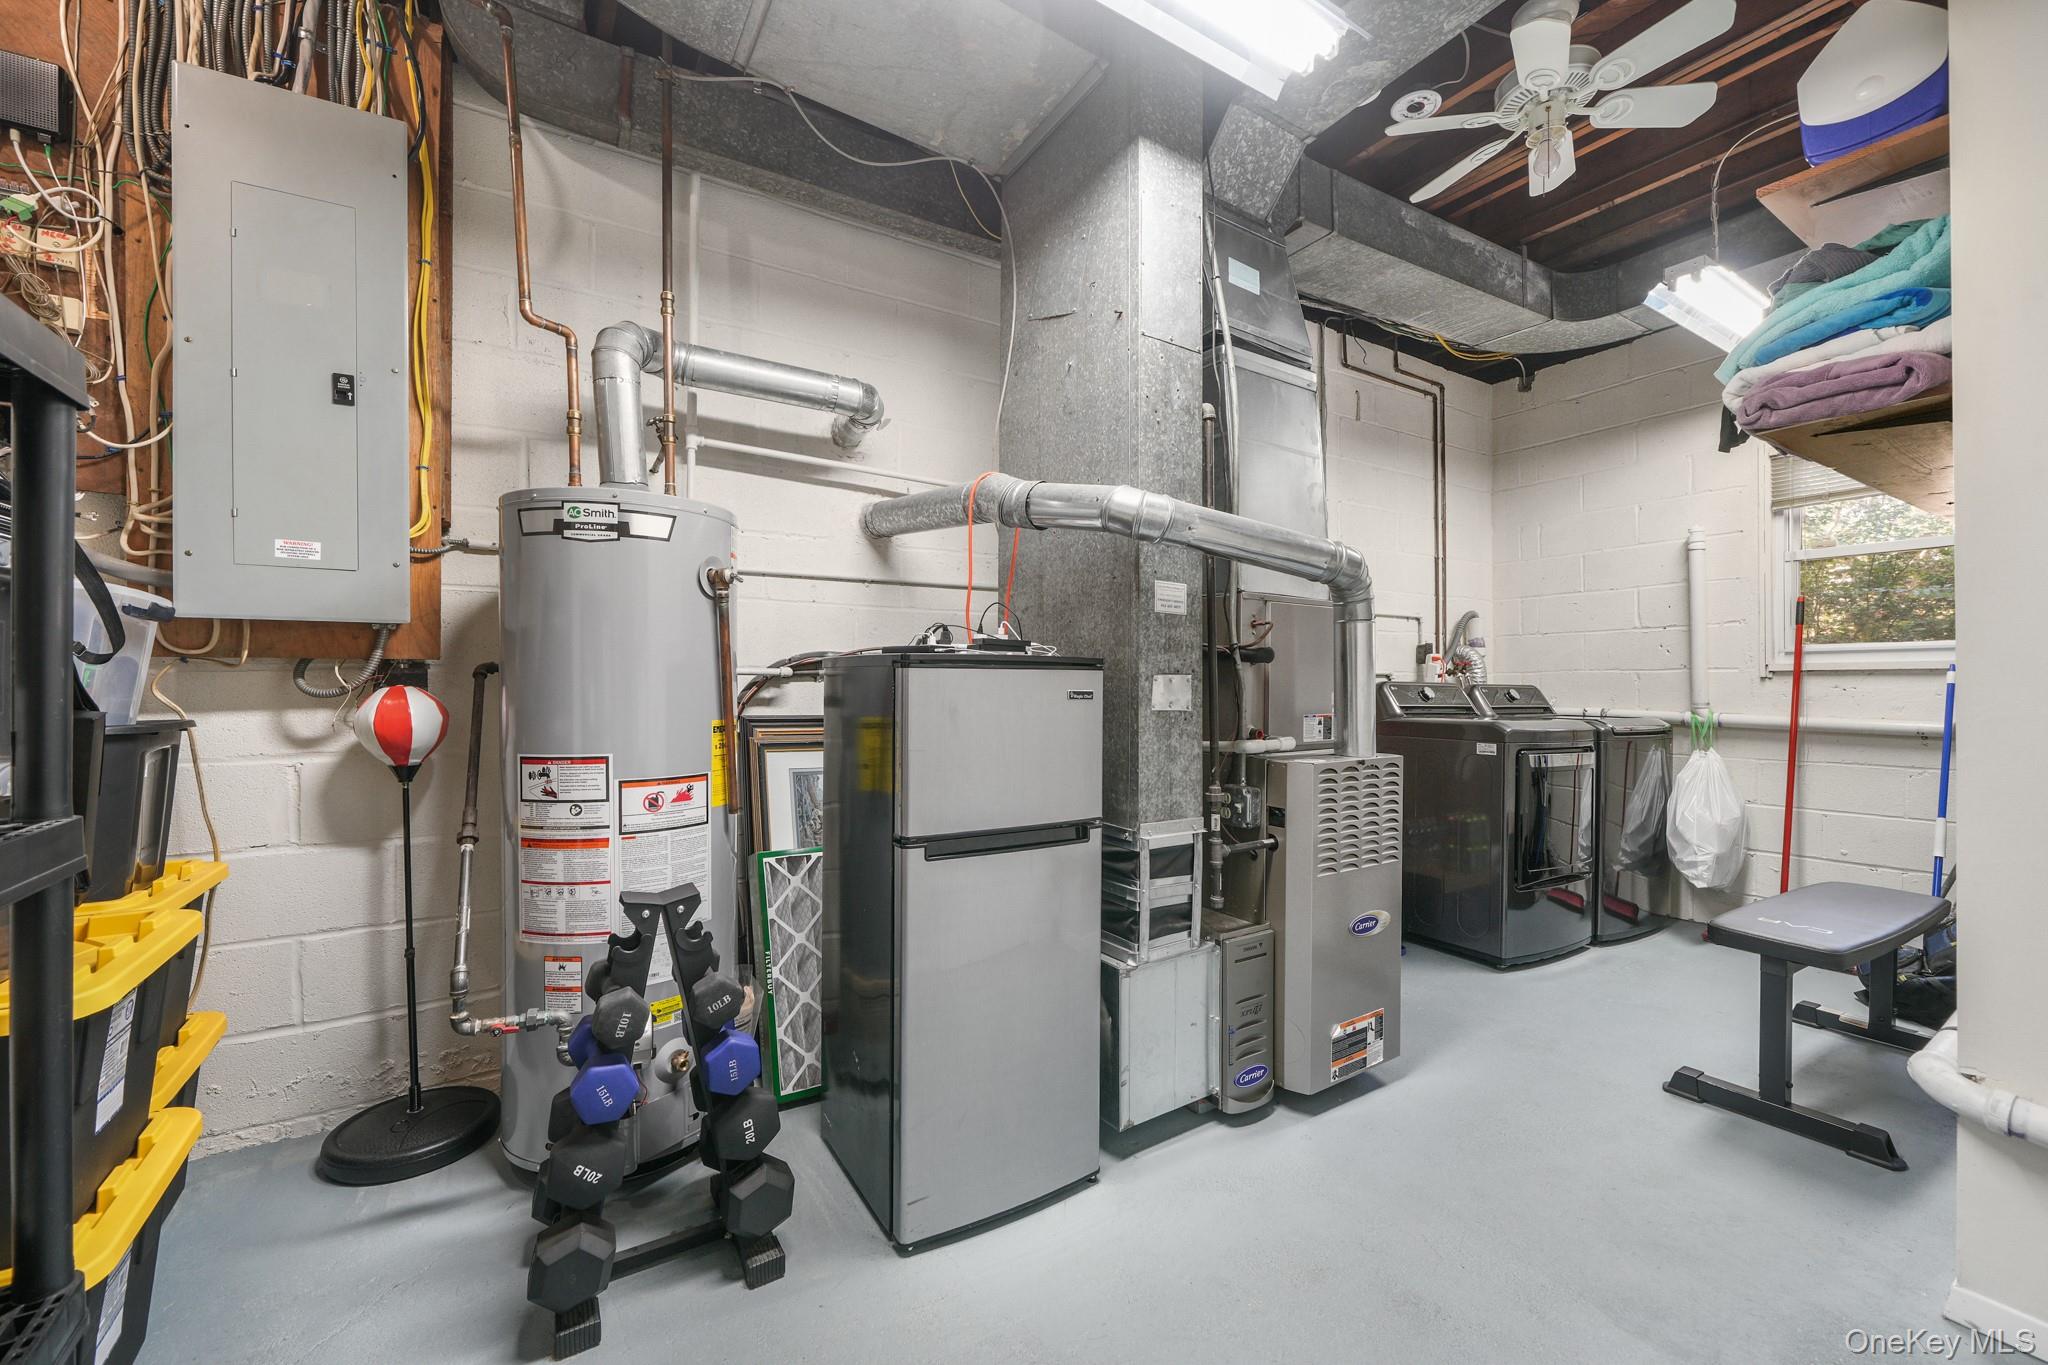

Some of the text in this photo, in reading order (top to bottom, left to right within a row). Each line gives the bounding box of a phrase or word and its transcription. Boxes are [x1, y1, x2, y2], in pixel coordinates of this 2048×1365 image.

[583, 508, 616, 519] Smith
[575, 523, 608, 531] ProLine
[1354, 919, 1377, 931] Carrier
[764, 951, 774, 994] FILTERBUY
[706, 994, 732, 1015] 10LB
[615, 1012, 632, 1038] 10LB
[728, 1059, 739, 1082] 15LB
[1239, 1068, 1265, 1084] Carrier
[596, 1085, 614, 1108] 15LB
[743, 1118, 756, 1145] 20LB
[573, 1164, 603, 1184] 20LB
